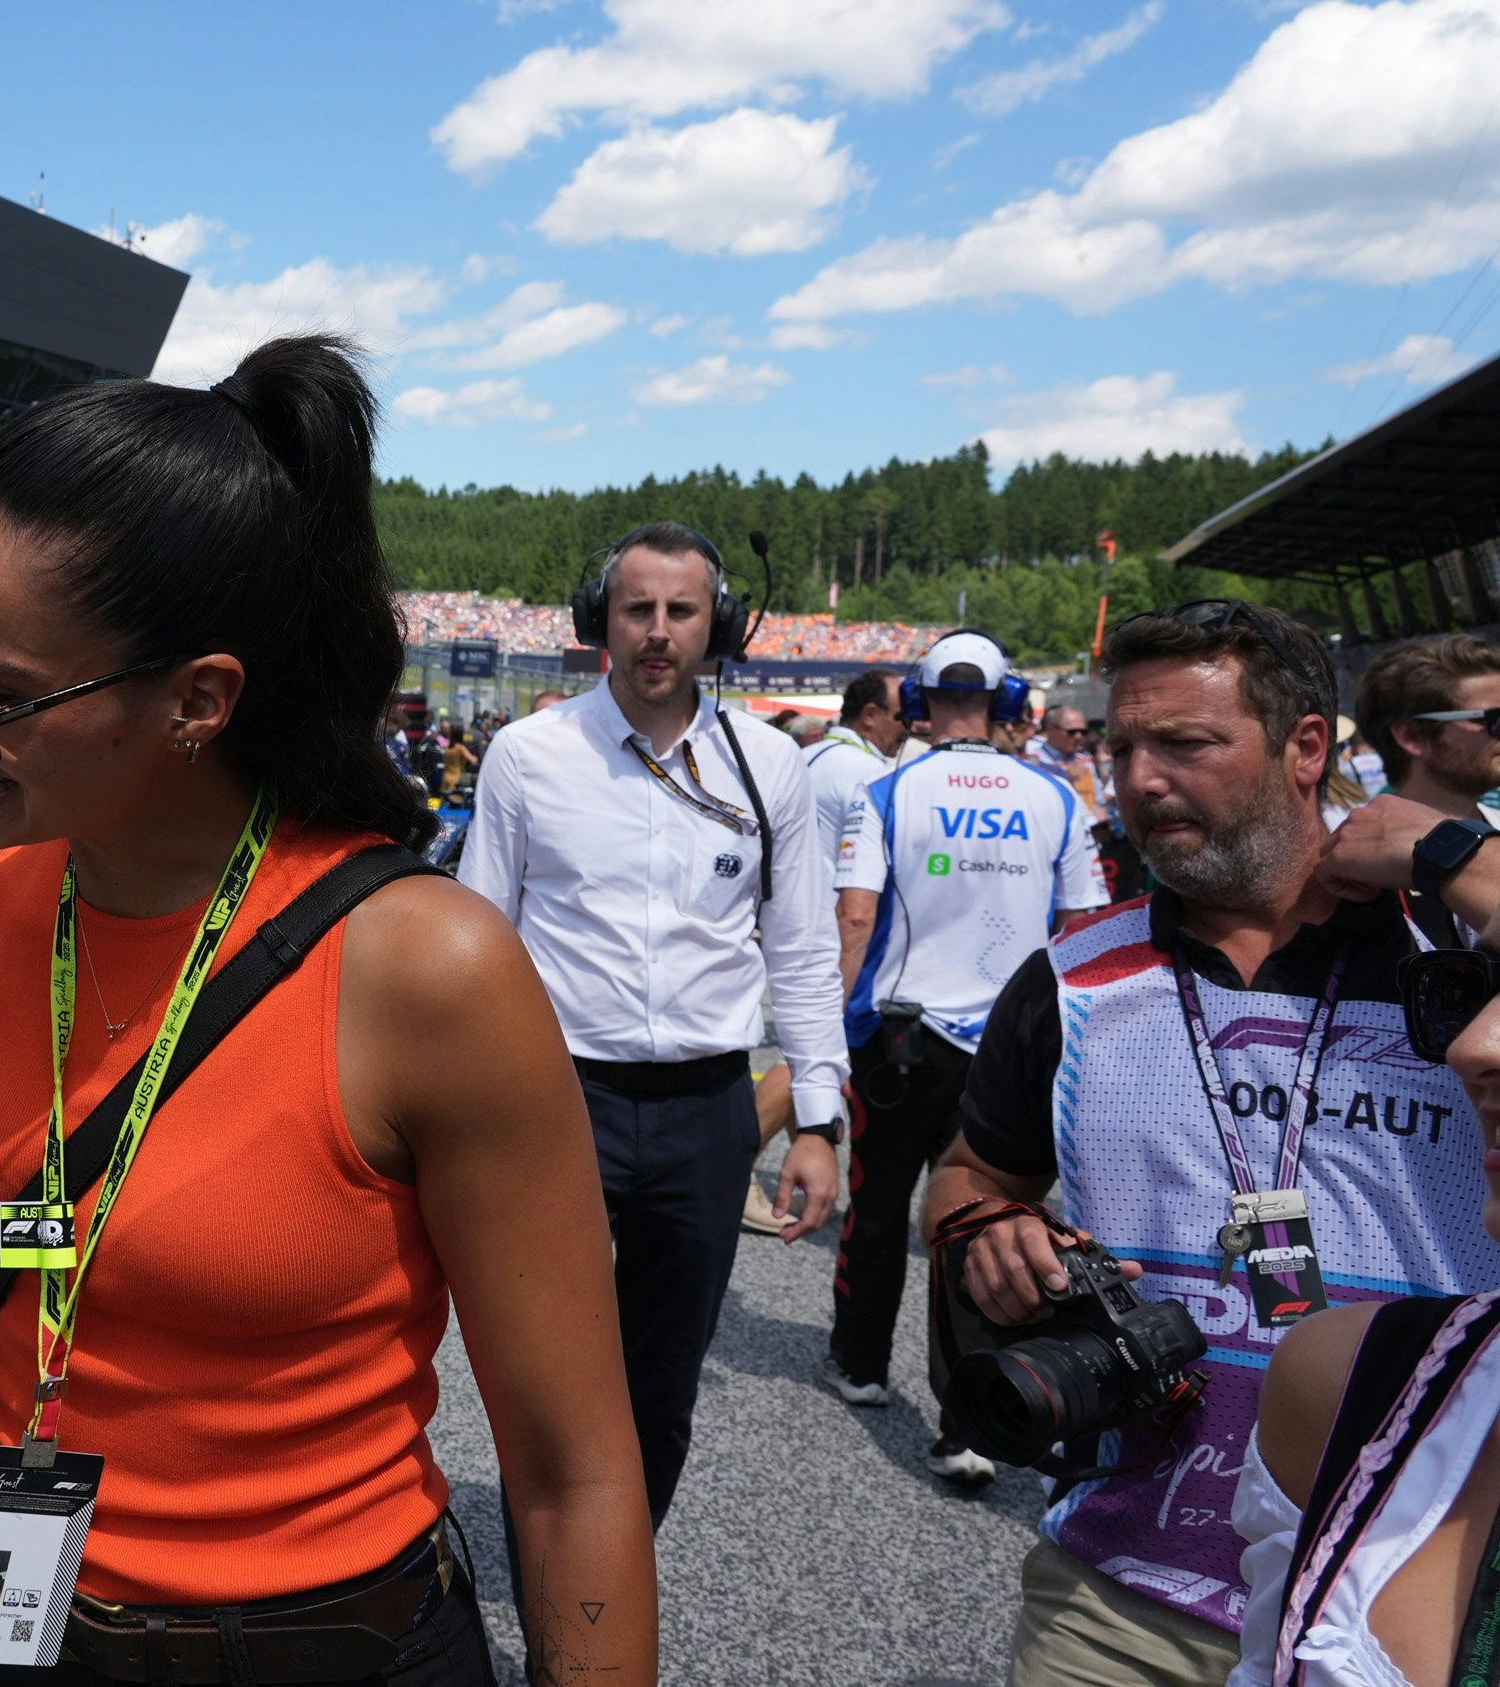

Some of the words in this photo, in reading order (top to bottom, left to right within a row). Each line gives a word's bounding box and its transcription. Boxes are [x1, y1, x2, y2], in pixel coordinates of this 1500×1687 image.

[948, 774, 1010, 790] HUGO
[934, 806, 1029, 841] VISA
[958, 859, 996, 873] Cash
[999, 860, 1029, 876] App
[205, 896, 230, 931] VIP
[1296, 1029, 1326, 1092] MEDIA
[133, 1036, 171, 1120] AUSTRIA
[1247, 1244, 1315, 1264] MEDIA
[1258, 1259, 1307, 1275] 2025
[1270, 1301, 1313, 1316] F1
[1115, 1336, 1141, 1372] Canon
